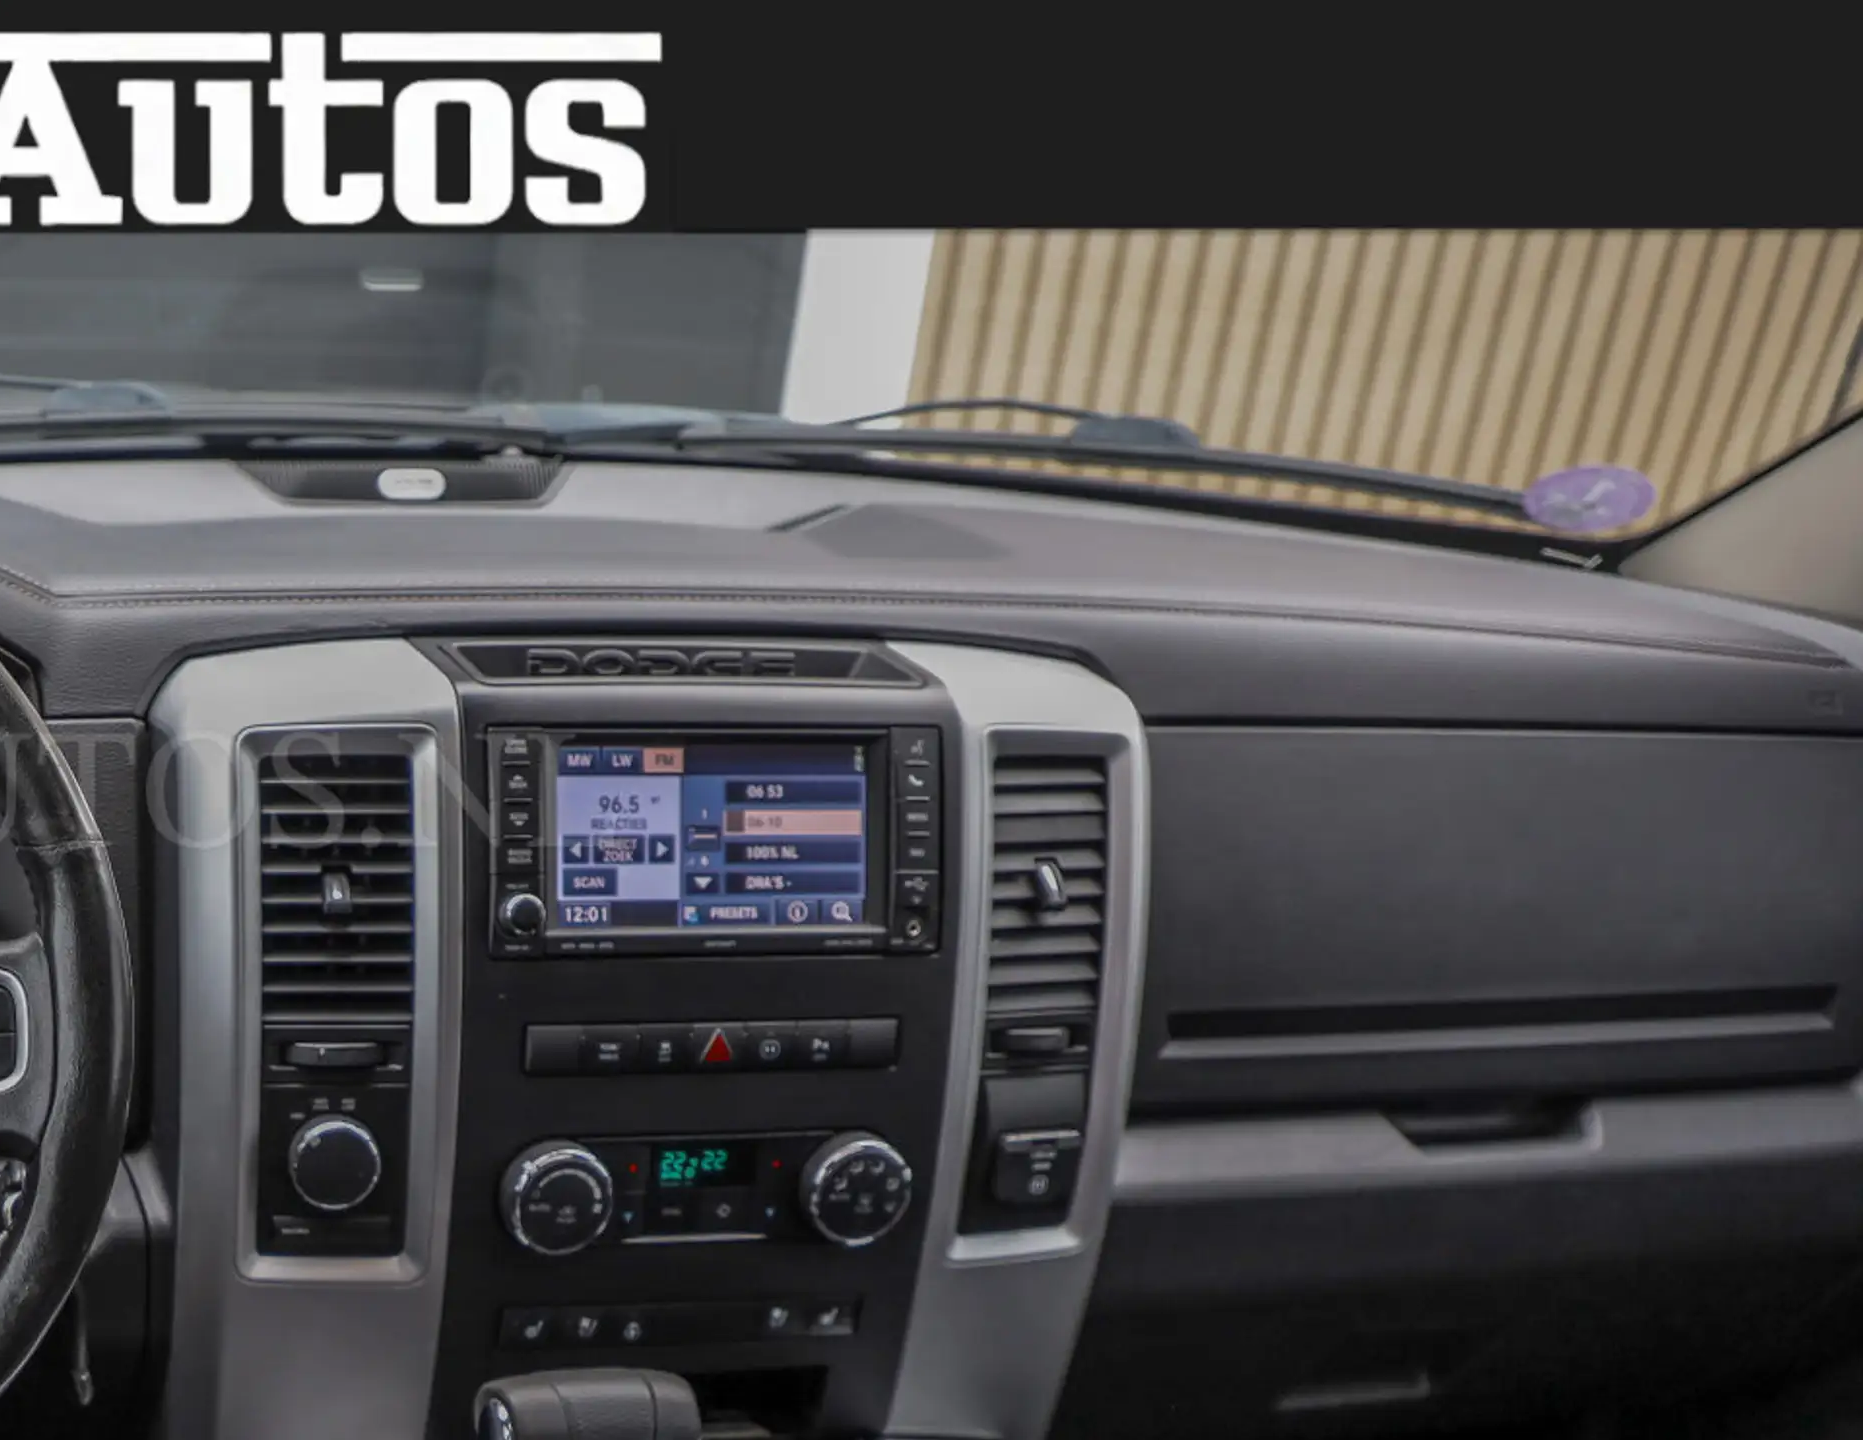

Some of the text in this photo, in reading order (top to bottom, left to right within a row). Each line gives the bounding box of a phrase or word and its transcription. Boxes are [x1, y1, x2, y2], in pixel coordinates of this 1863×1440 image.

[527, 647, 796, 677] DODGE
[566, 753, 594, 768] MW
[611, 753, 634, 768] LW
[654, 753, 675, 766] FM
[598, 794, 640, 814] 96.5
[603, 850, 635, 863] ZOEK
[572, 875, 606, 889] SCAN
[564, 905, 608, 923] 12:01
[709, 905, 759, 920] PRESETS
